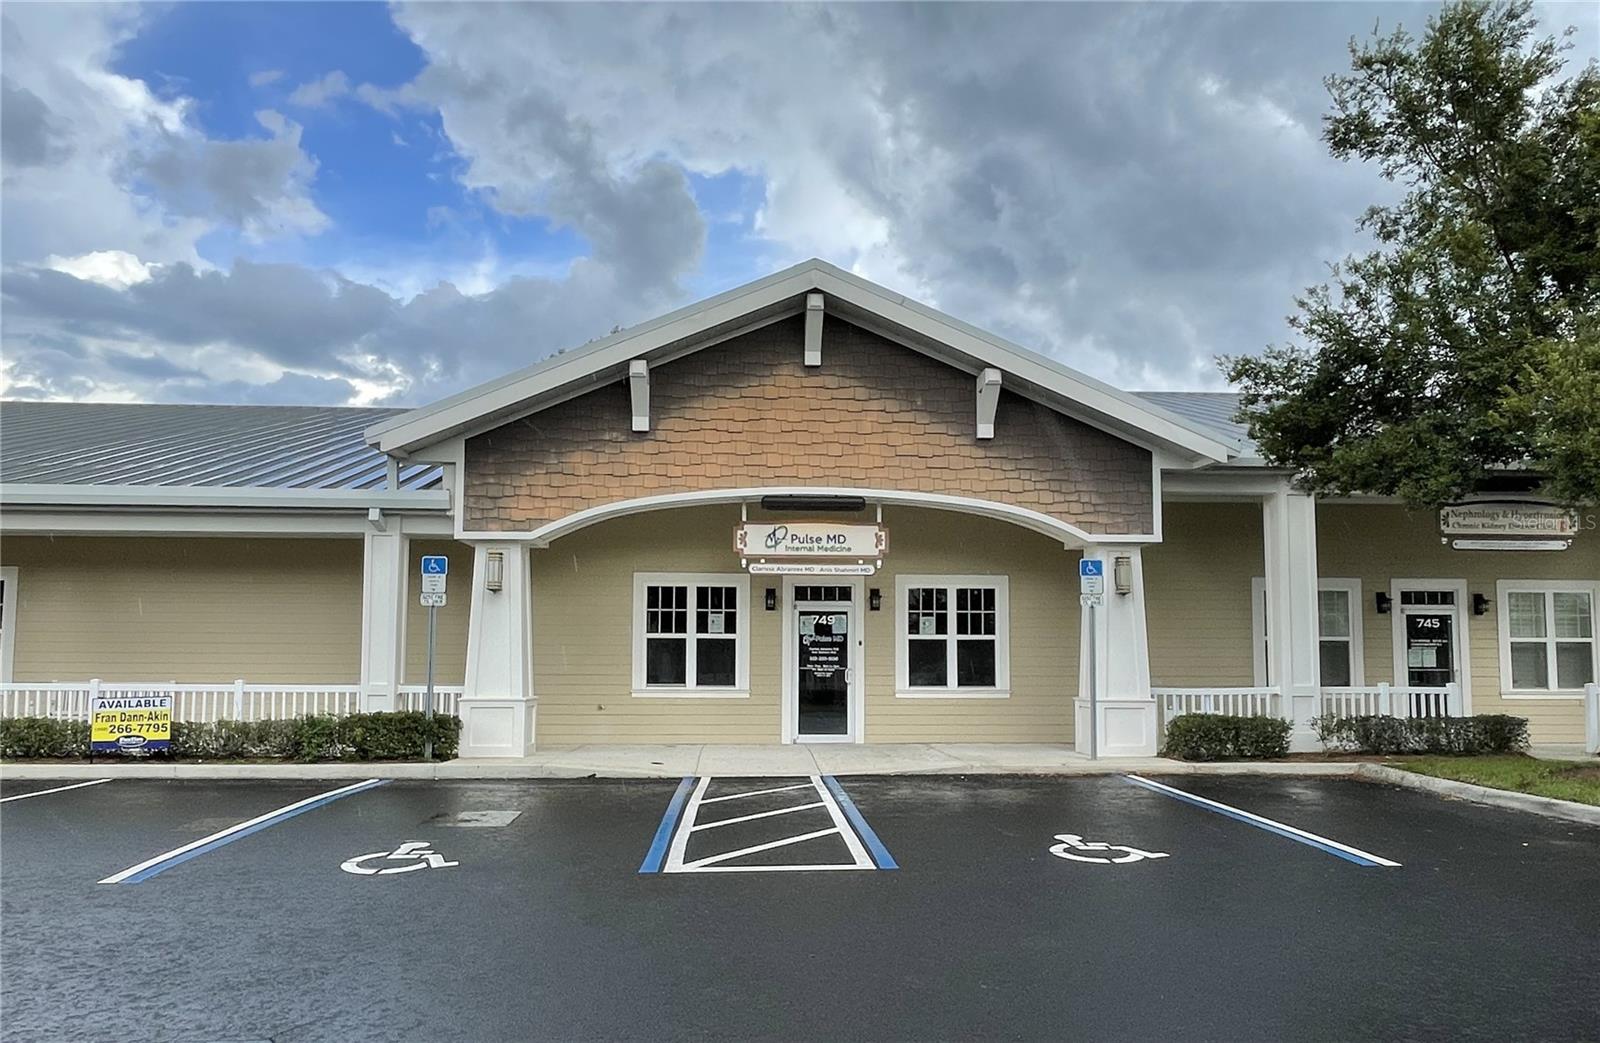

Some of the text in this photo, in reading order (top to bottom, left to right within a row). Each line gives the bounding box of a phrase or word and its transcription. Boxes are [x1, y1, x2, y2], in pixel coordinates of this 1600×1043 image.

[1450, 509, 1500, 521] Nephrology
[790, 534, 847, 544] Pulse MD
[817, 545, 852, 553] Medicine
[812, 615, 836, 625] 749
[1416, 618, 1440, 628] 745
[98, 699, 167, 709] AVAILABLE
[95, 711, 169, 723] Fran Dann-Akin
[108, 723, 168, 734] 266-7795
